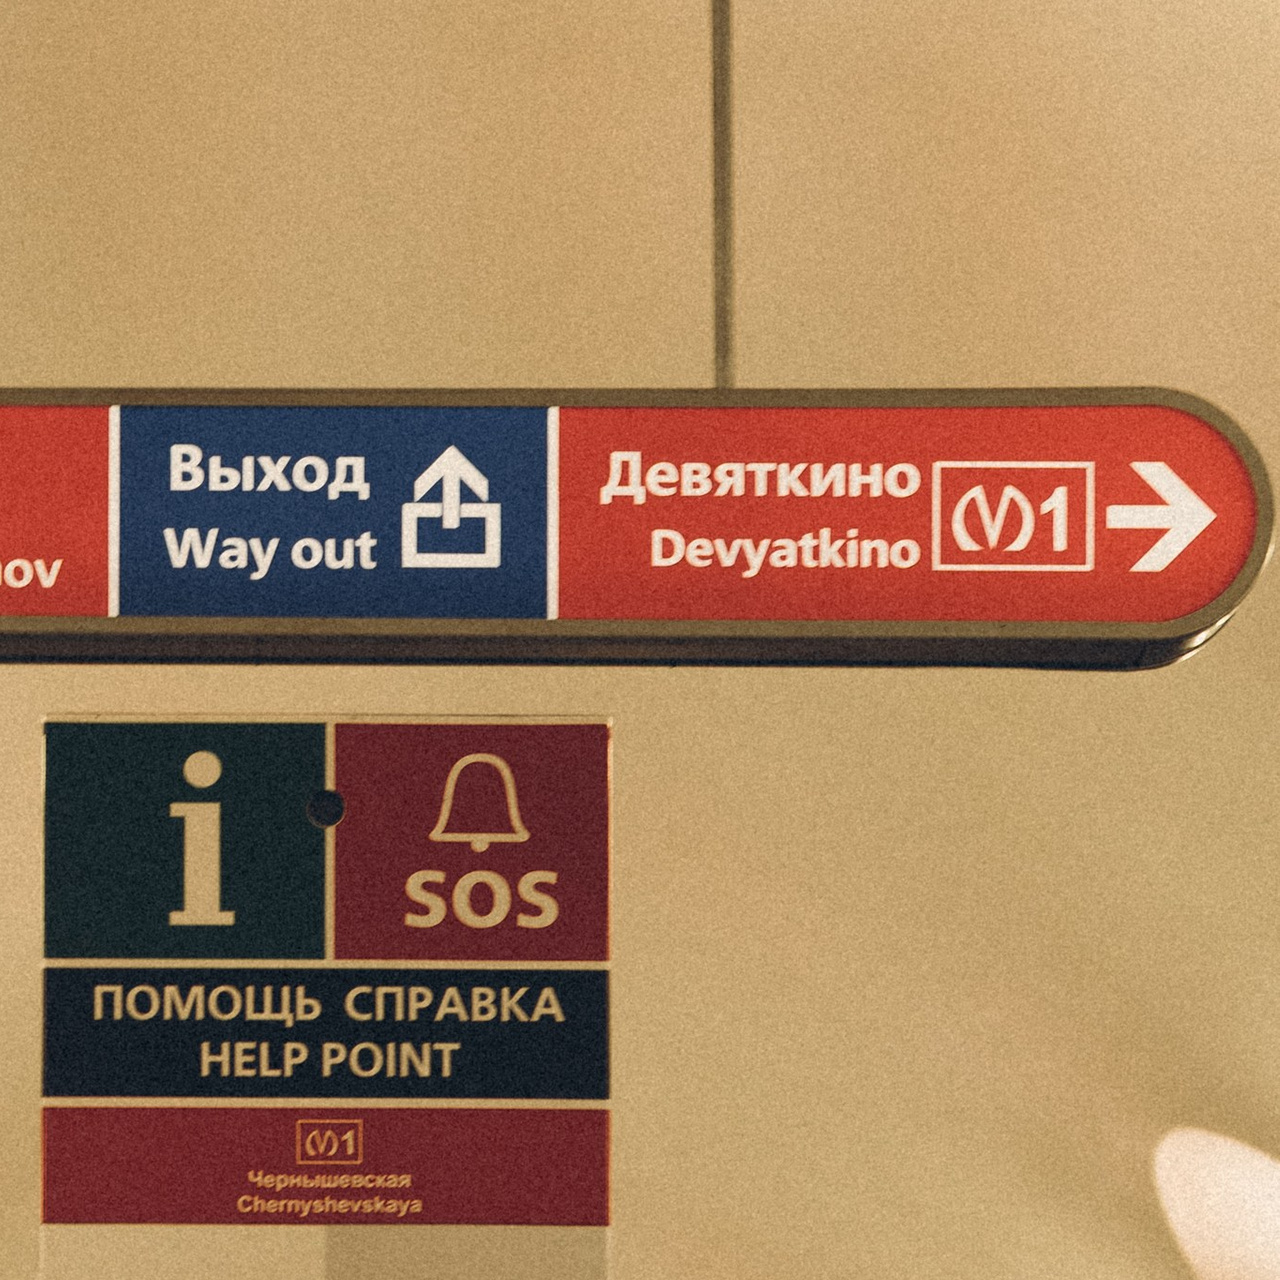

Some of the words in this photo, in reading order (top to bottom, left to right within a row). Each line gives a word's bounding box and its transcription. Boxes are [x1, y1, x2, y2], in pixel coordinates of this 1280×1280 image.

[170, 444, 370, 500] Выход
[600, 451, 920, 504] Девяткино
[164, 528, 279, 580] Way
[292, 532, 377, 569] out
[652, 528, 920, 577] Devyatkino
[405, 870, 558, 928] SOS
[94, 985, 321, 1027] ПОМОЩЬ
[345, 986, 564, 1022] СПРАВКА
[201, 1042, 308, 1076] HELP
[323, 1042, 460, 1077] POINT
[248, 1171, 411, 1191] Чернышевская
[237, 1195, 422, 1217] Chernyshevskaya
